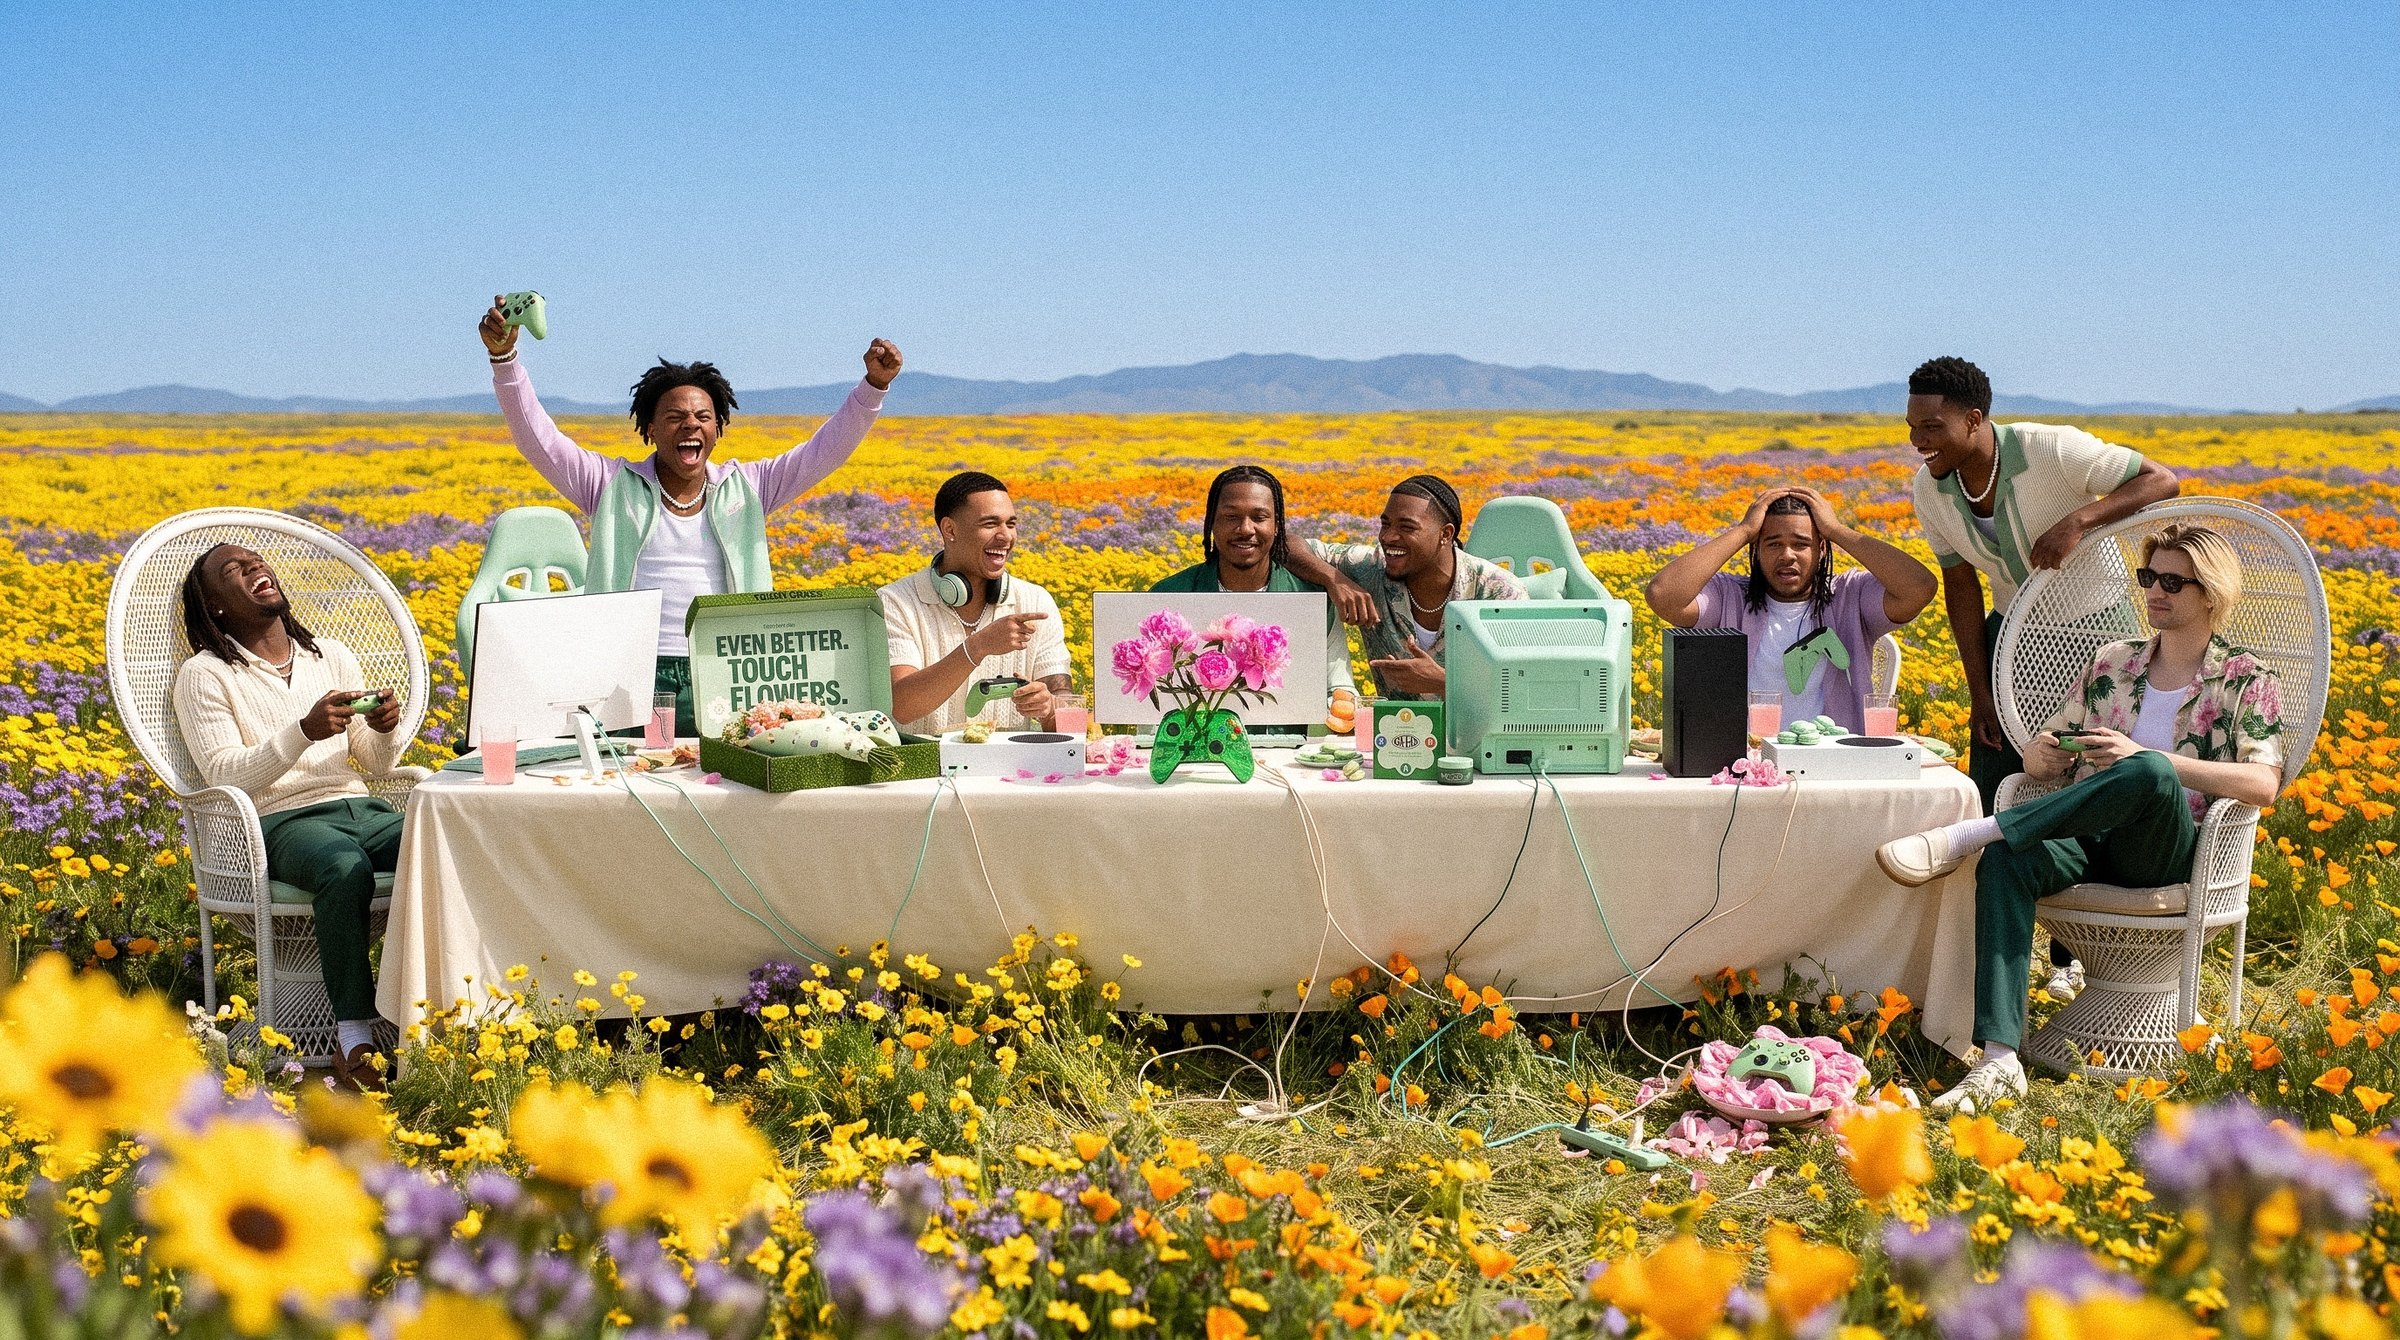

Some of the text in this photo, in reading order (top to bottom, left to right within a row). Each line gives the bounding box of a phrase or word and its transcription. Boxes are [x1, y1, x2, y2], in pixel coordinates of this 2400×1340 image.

[716, 629, 849, 657] EVEN BETTER.
[727, 654, 808, 684] TOUCH
